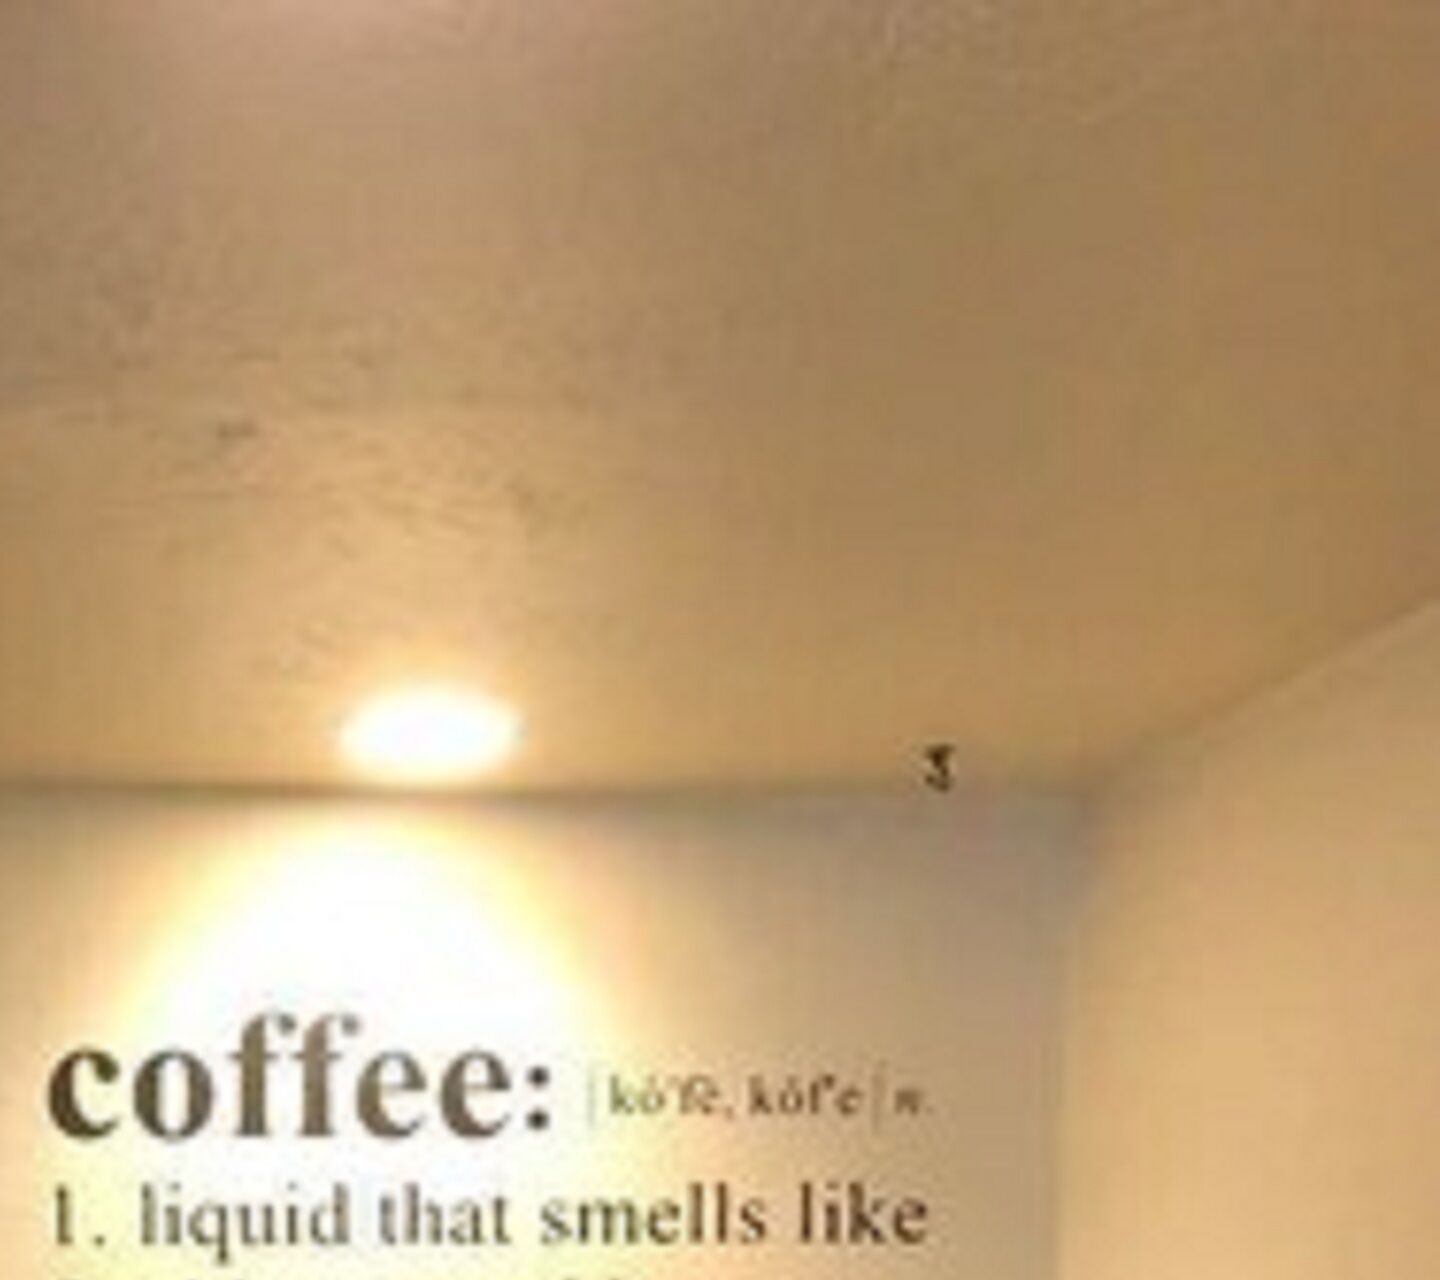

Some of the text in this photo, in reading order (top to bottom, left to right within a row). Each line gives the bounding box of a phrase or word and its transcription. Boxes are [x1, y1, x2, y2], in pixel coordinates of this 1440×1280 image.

[47, 1012, 551, 1141] coffee:
[141, 1182, 350, 1266] liquid
[378, 1182, 511, 1246] that
[539, 1181, 767, 1246] smells
[800, 1181, 929, 1246] like
